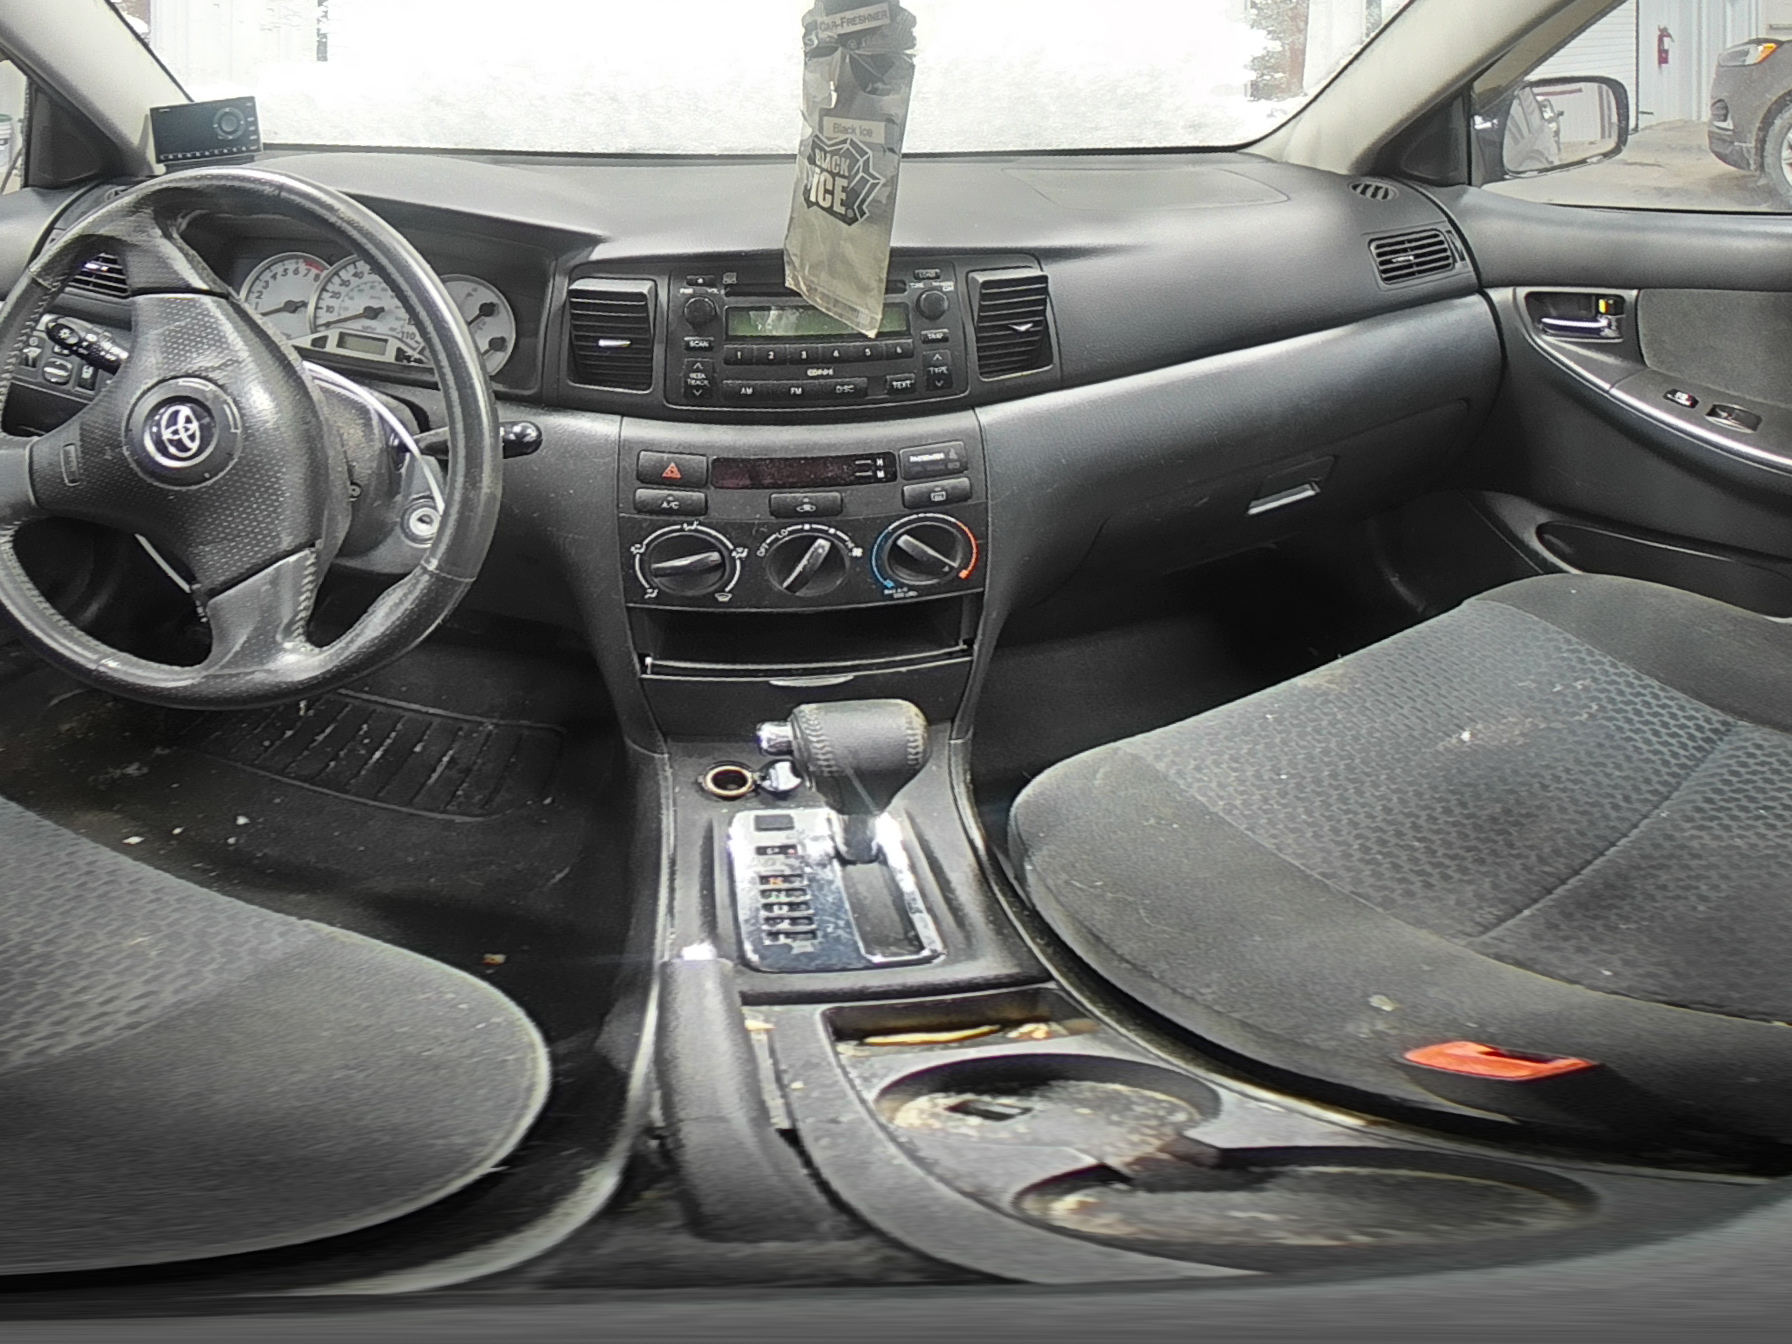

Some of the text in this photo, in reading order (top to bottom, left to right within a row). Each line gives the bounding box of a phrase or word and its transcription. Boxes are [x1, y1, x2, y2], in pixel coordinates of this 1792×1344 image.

[832, 122, 857, 136] Black
[814, 148, 850, 176] BLACK
[352, 270, 365, 280] 40
[329, 290, 342, 300] 20
[325, 305, 335, 314] 10
[740, 386, 754, 395] AM
[790, 386, 803, 396] FM
[660, 501, 680, 510] A/C
